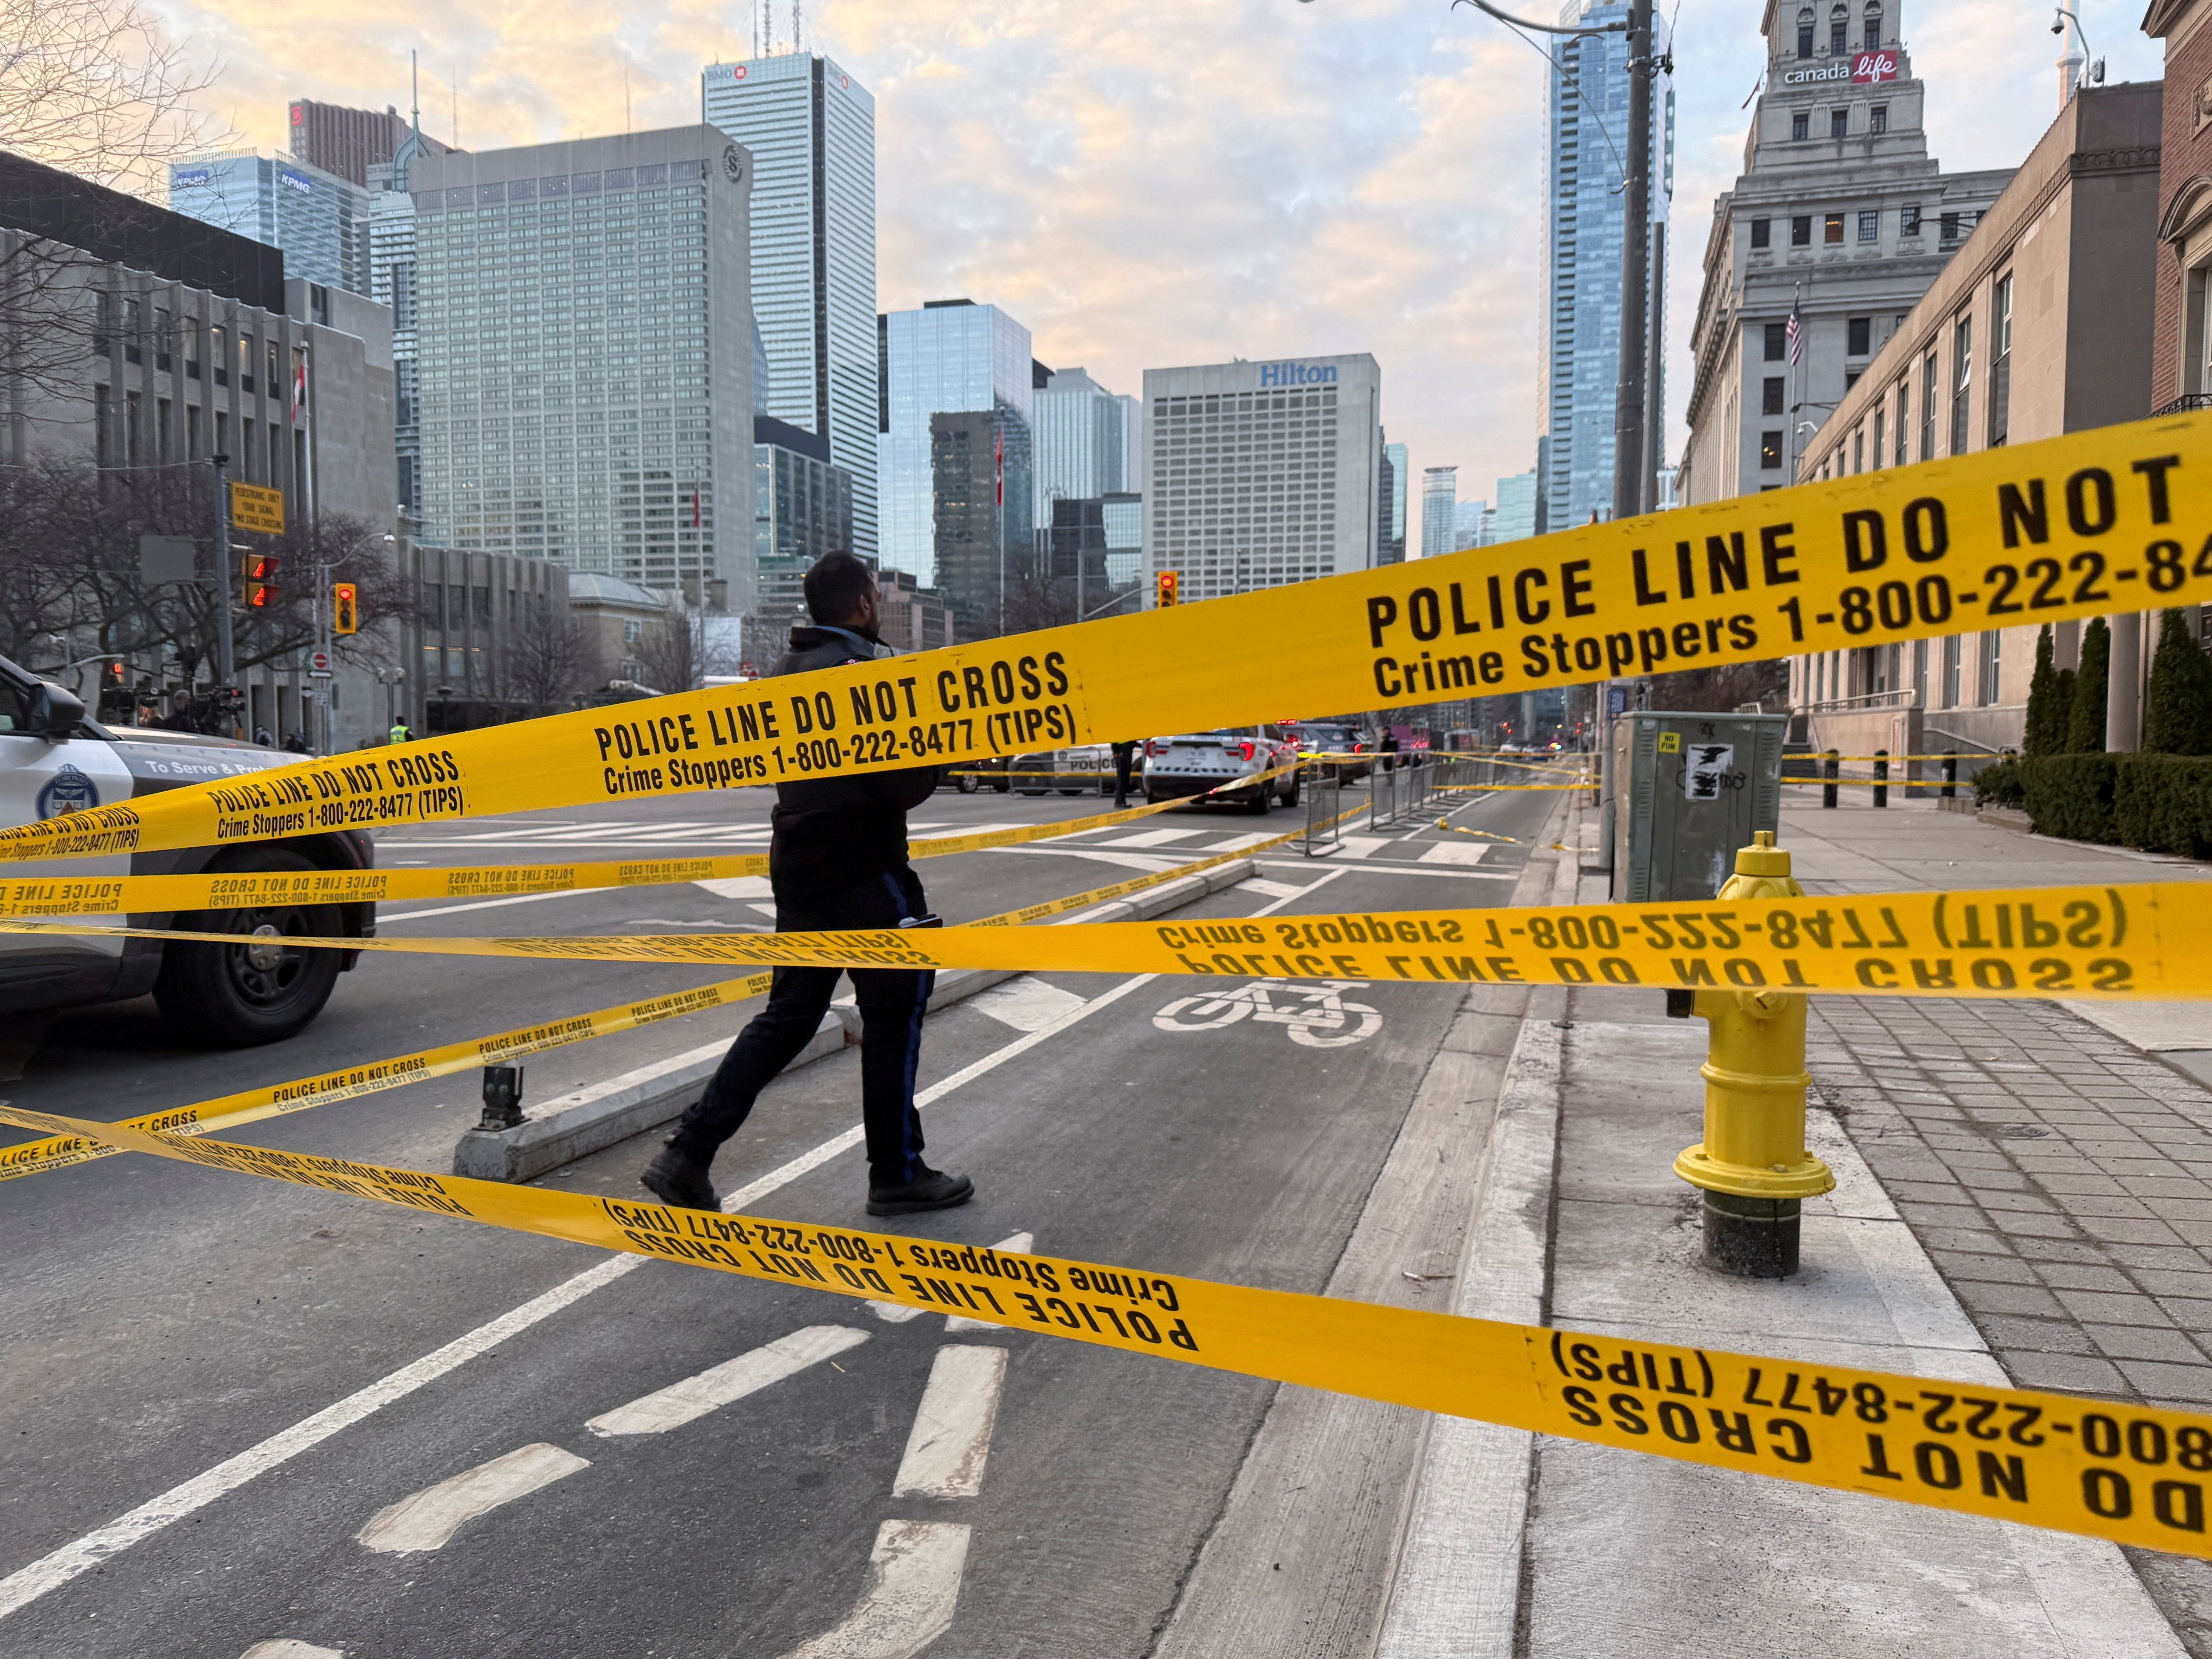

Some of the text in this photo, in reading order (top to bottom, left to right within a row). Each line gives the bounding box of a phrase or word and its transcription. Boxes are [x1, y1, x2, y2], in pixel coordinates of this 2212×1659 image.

[707, 69, 732, 80] BMO
[1784, 54, 1897, 84] canada life
[281, 173, 311, 194] KPMG
[1260, 362, 1337, 387] Hilton
[235, 487, 265, 500] PEDESTRIANS
[1367, 454, 2181, 648] POLICE LINE DO NOT
[1373, 650, 1503, 698] Crime
[1521, 613, 1758, 677] Stoppers
[595, 651, 1069, 761] POLICE LINE DO NOT CROSS
[603, 703, 1076, 795] Crime Stoppers 1-800-222-8477 (TIPS)
[54, 773, 89, 786] TORONTO
[145, 760, 163, 773] To
[171, 761, 217, 774] Serve
[220, 764, 234, 774] &
[206, 750, 458, 813] POLICE LINE DO NOT CROSS
[27, 822, 53, 837] LINE
[53, 818, 71, 833] DO
[69, 812, 96, 832] NOT
[91, 806, 139, 828] CROSS
[218, 786, 463, 839] Crime Stoppers 1-800-222-8477 (TIPS)
[10, 842, 45, 861] Stoppers
[45, 832, 112, 855] 1-800-222-8477
[110, 828, 139, 854] (TIPS)
[631, 1004, 655, 1016] POLICE
[658, 999, 672, 1010] LINE
[479, 1037, 510, 1054] POLICE
[514, 1032, 531, 1046] LINE
[535, 1029, 545, 1040] DO
[549, 1024, 564, 1037] NOT
[567, 1018, 592, 1032] CROSS
[274, 1057, 425, 1103] POLICE LINE DO NOT CROSS
[277, 1100, 305, 1112] Crime
[307, 1090, 343, 1105] Stoppers
[46, 1138, 83, 1157] LINE
[151, 1110, 197, 1131] CROSS
[27, 1151, 80, 1172] Stoppers
[238, 1161, 292, 1181] NOT
[306, 1158, 390, 1185] Stoppers
[282, 1168, 325, 1187] DO
[315, 1174, 381, 1198] LINE
[384, 1170, 447, 1195] Crime
[373, 1185, 475, 1216] POLICE
[602, 1198, 1180, 1312] Crime Stoppers 1-800-222-8477 (TIPS)
[624, 1230, 1200, 1351] POLICE LINE DO NOT CROSS
[1550, 1330, 1714, 1400] (TIPS)
[1561, 1384, 2205, 1534] DO NOT CROSS
